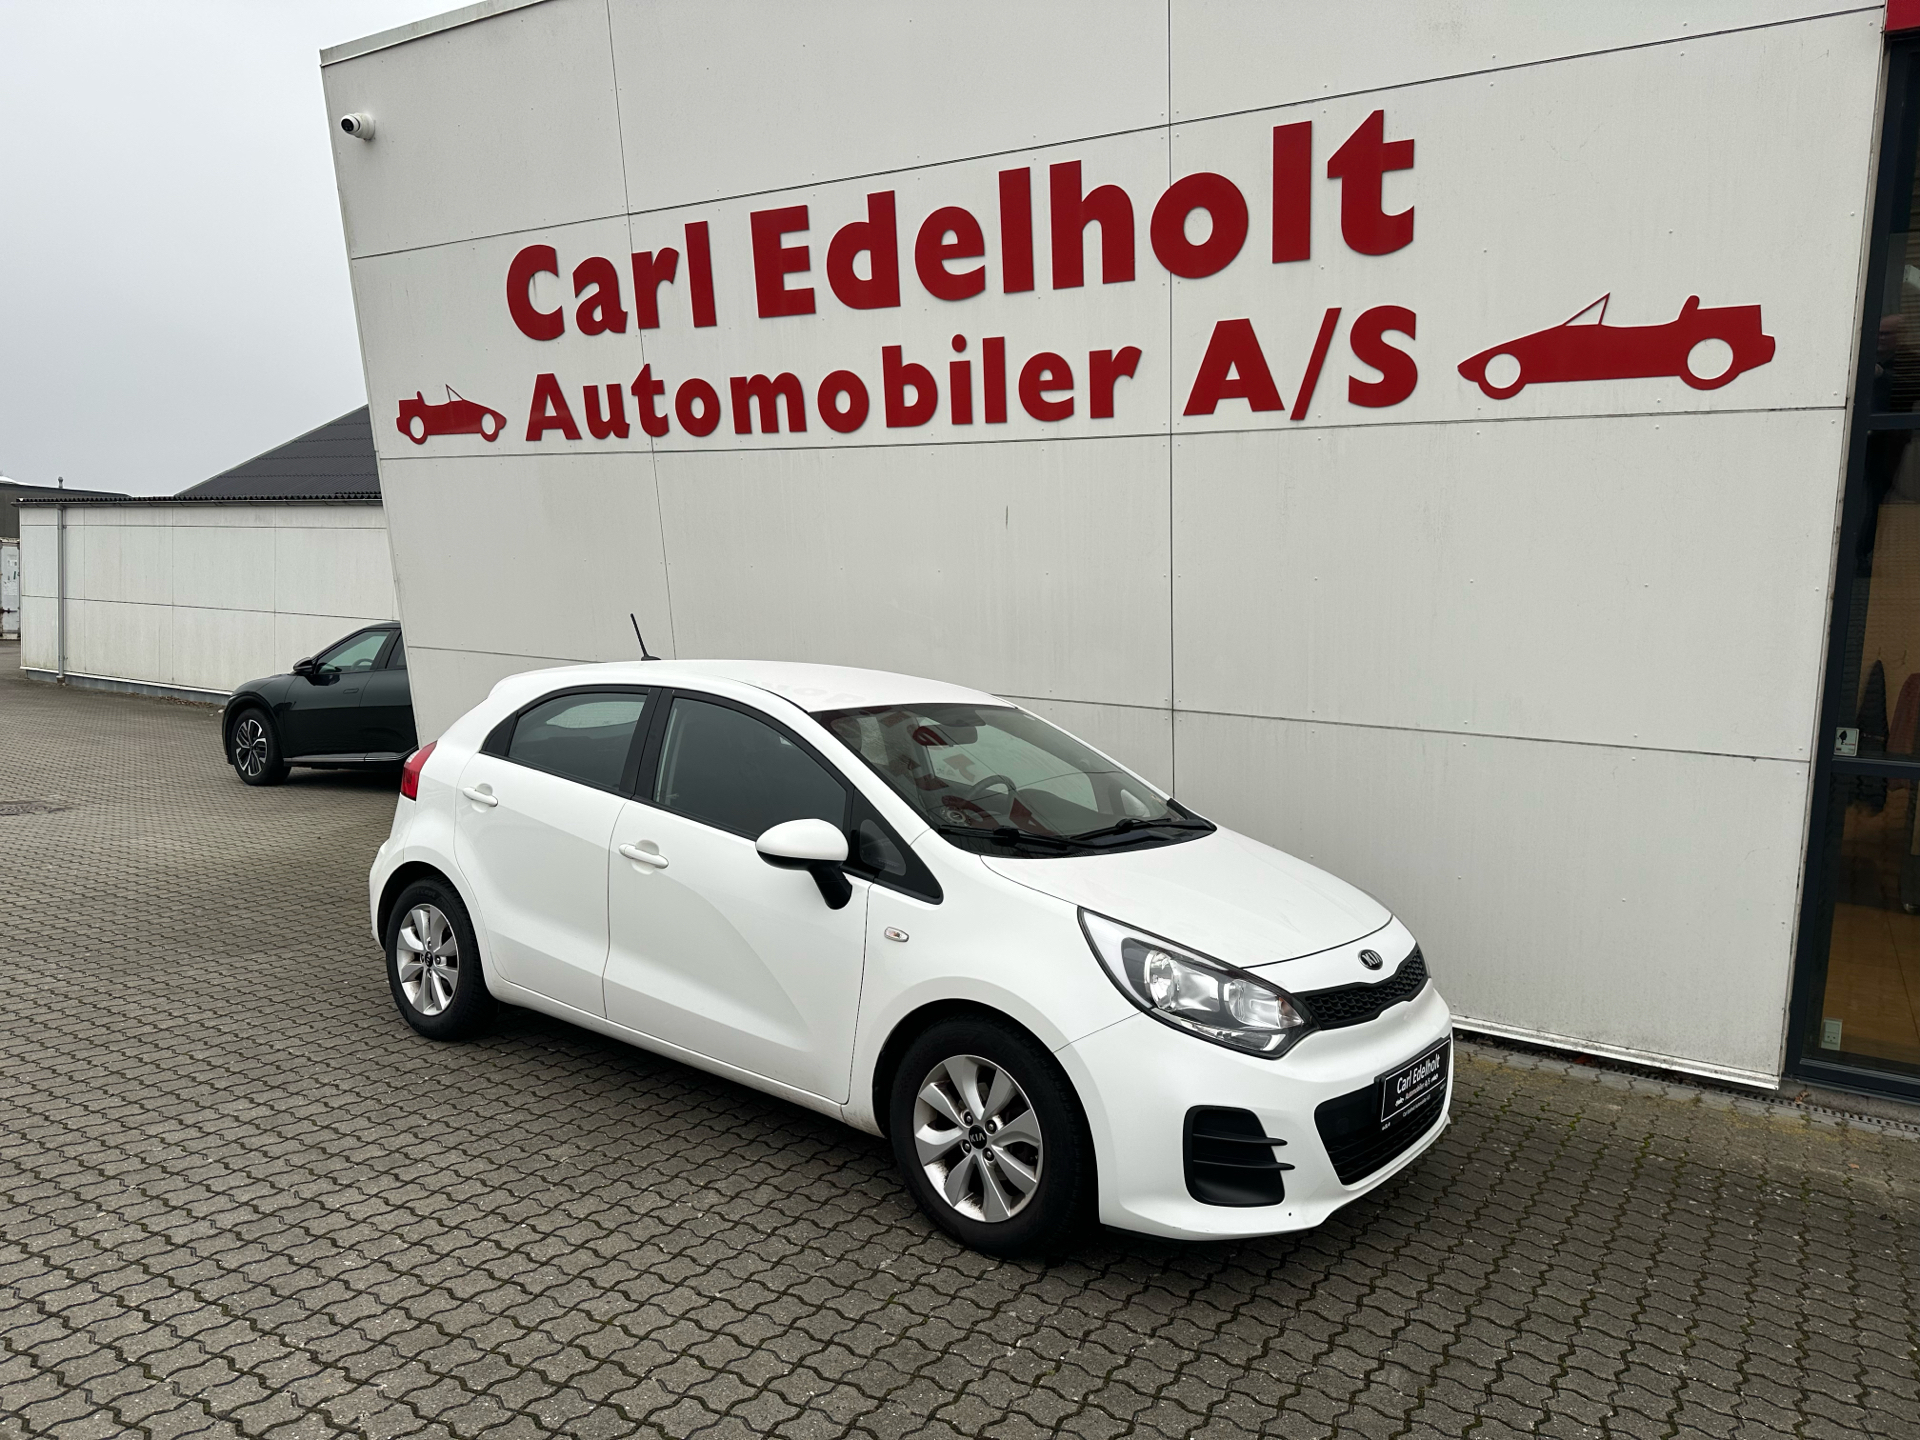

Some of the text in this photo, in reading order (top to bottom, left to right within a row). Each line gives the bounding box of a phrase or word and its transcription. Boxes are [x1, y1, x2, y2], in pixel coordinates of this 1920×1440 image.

[507, 110, 1415, 340] Carl Edelholt
[526, 305, 1418, 441] Automobiler A/S
[1362, 952, 1380, 967] KIA
[1396, 1070, 1412, 1094] Carl
[1412, 1053, 1440, 1084] Edelholt
[970, 1132, 986, 1142] KIA
